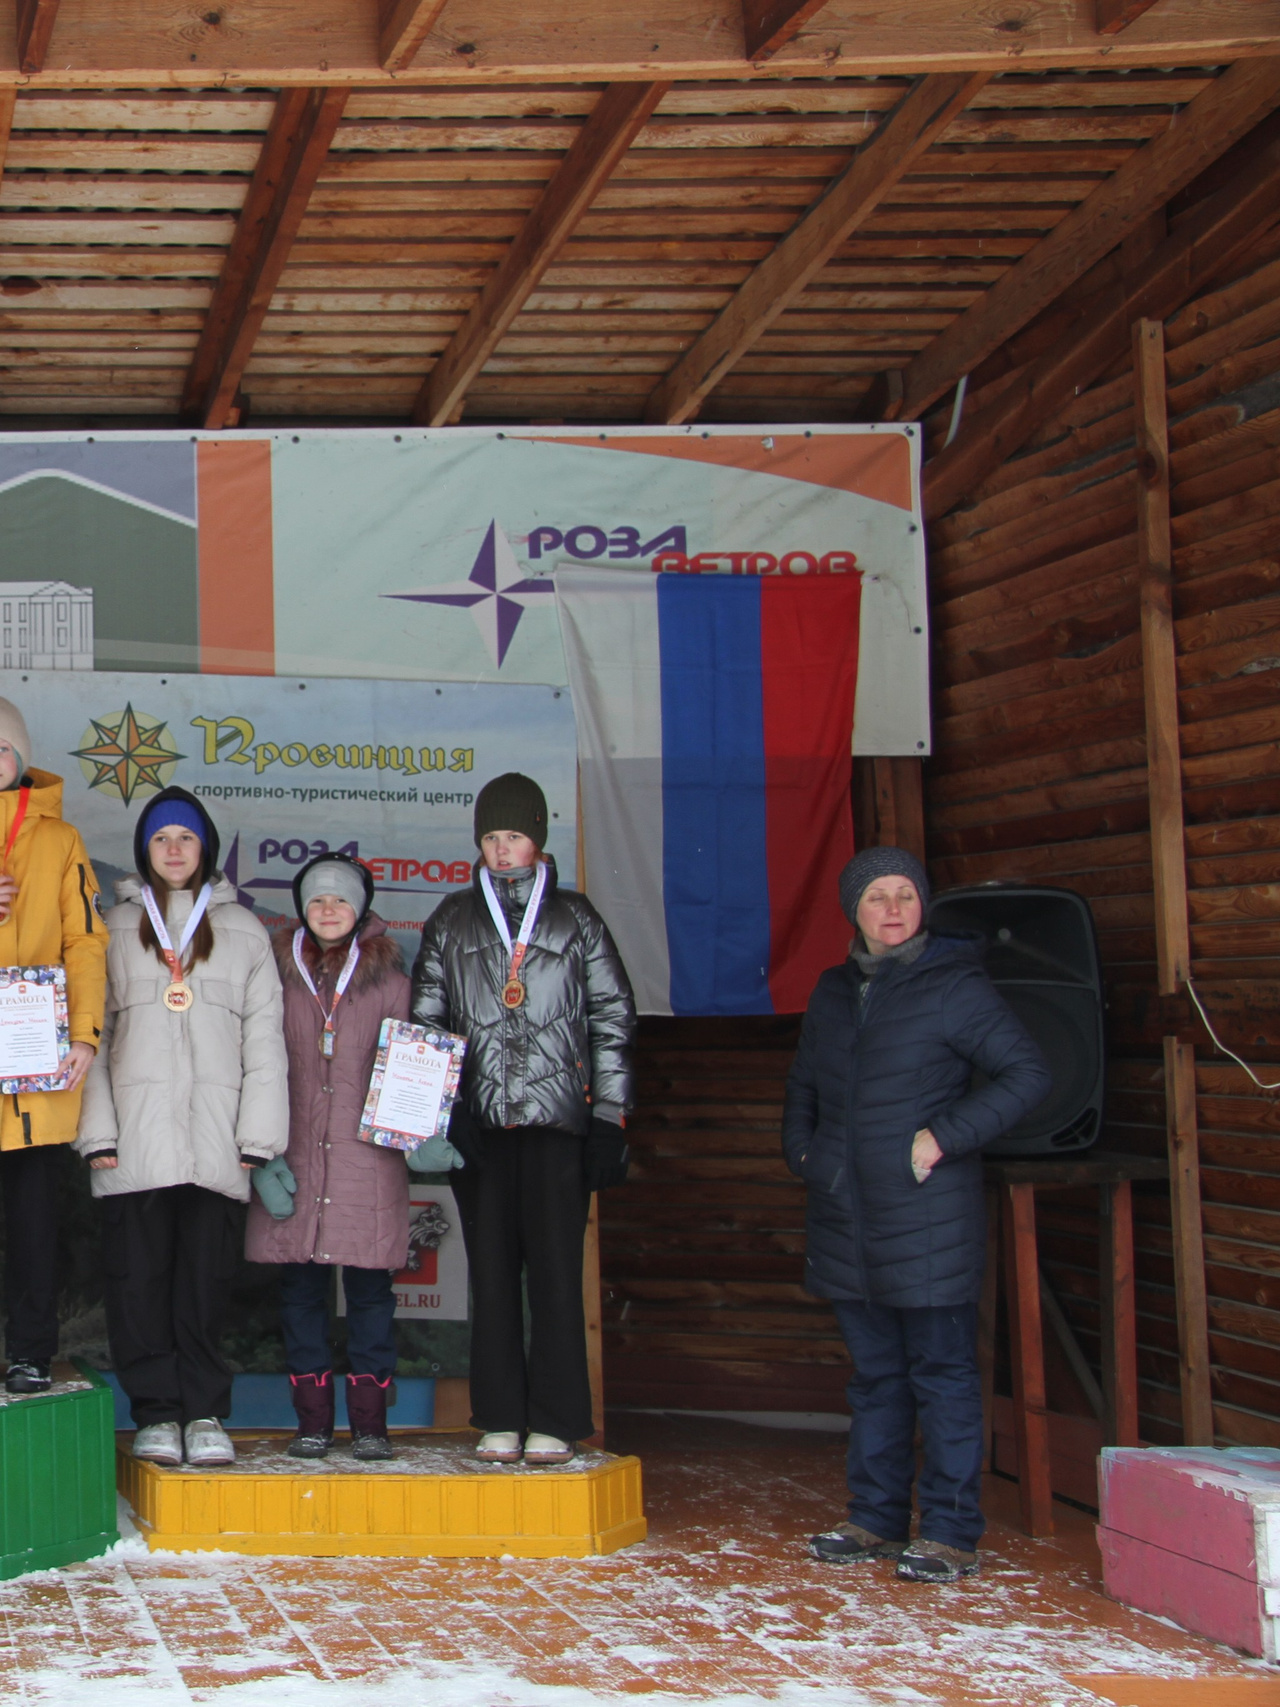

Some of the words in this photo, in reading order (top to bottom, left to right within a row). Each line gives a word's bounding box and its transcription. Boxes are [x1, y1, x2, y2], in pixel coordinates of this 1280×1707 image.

[528, 525, 687, 559] РОЗА
[190, 715, 474, 775] Провинция
[193, 784, 418, 802] спортивно-туристический
[424, 790, 474, 807] центр
[0, 995, 48, 1006] ГРАМОТА
[395, 1052, 442, 1069] ГРАМОТА
[395, 1293, 441, 1308] EL.RU
